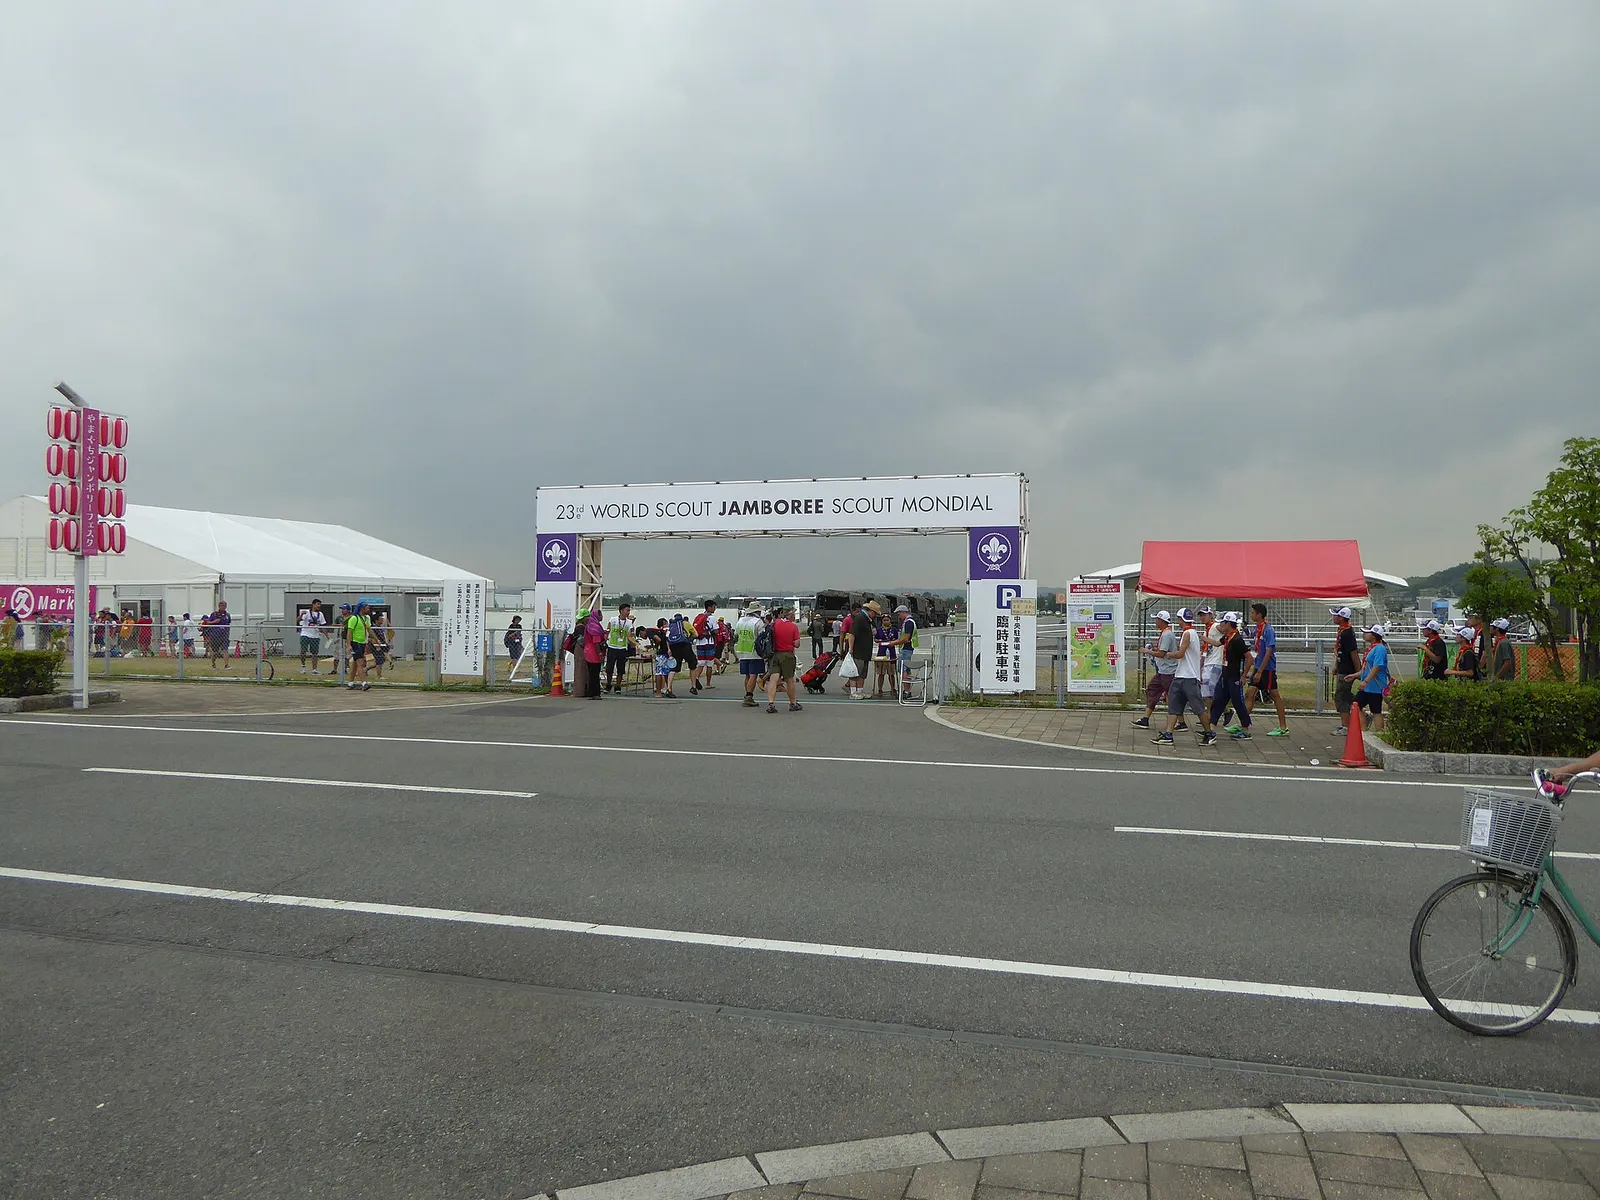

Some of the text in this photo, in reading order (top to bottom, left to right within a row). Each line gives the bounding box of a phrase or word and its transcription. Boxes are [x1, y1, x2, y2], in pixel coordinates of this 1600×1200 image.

[86, 414, 96, 547] やまぐちジャンボリーフェスタ
[590, 503, 649, 519] WORLD
[655, 501, 713, 518] SCOUT
[719, 498, 824, 517] JAMBOREE
[831, 496, 894, 515] SCOUT
[901, 494, 994, 513] MONDIAL
[1002, 588, 1017, 607] P
[996, 615, 1009, 683] 臨時駐車場
[1013, 616, 1021, 684] 中央駐車場・東駐車場
